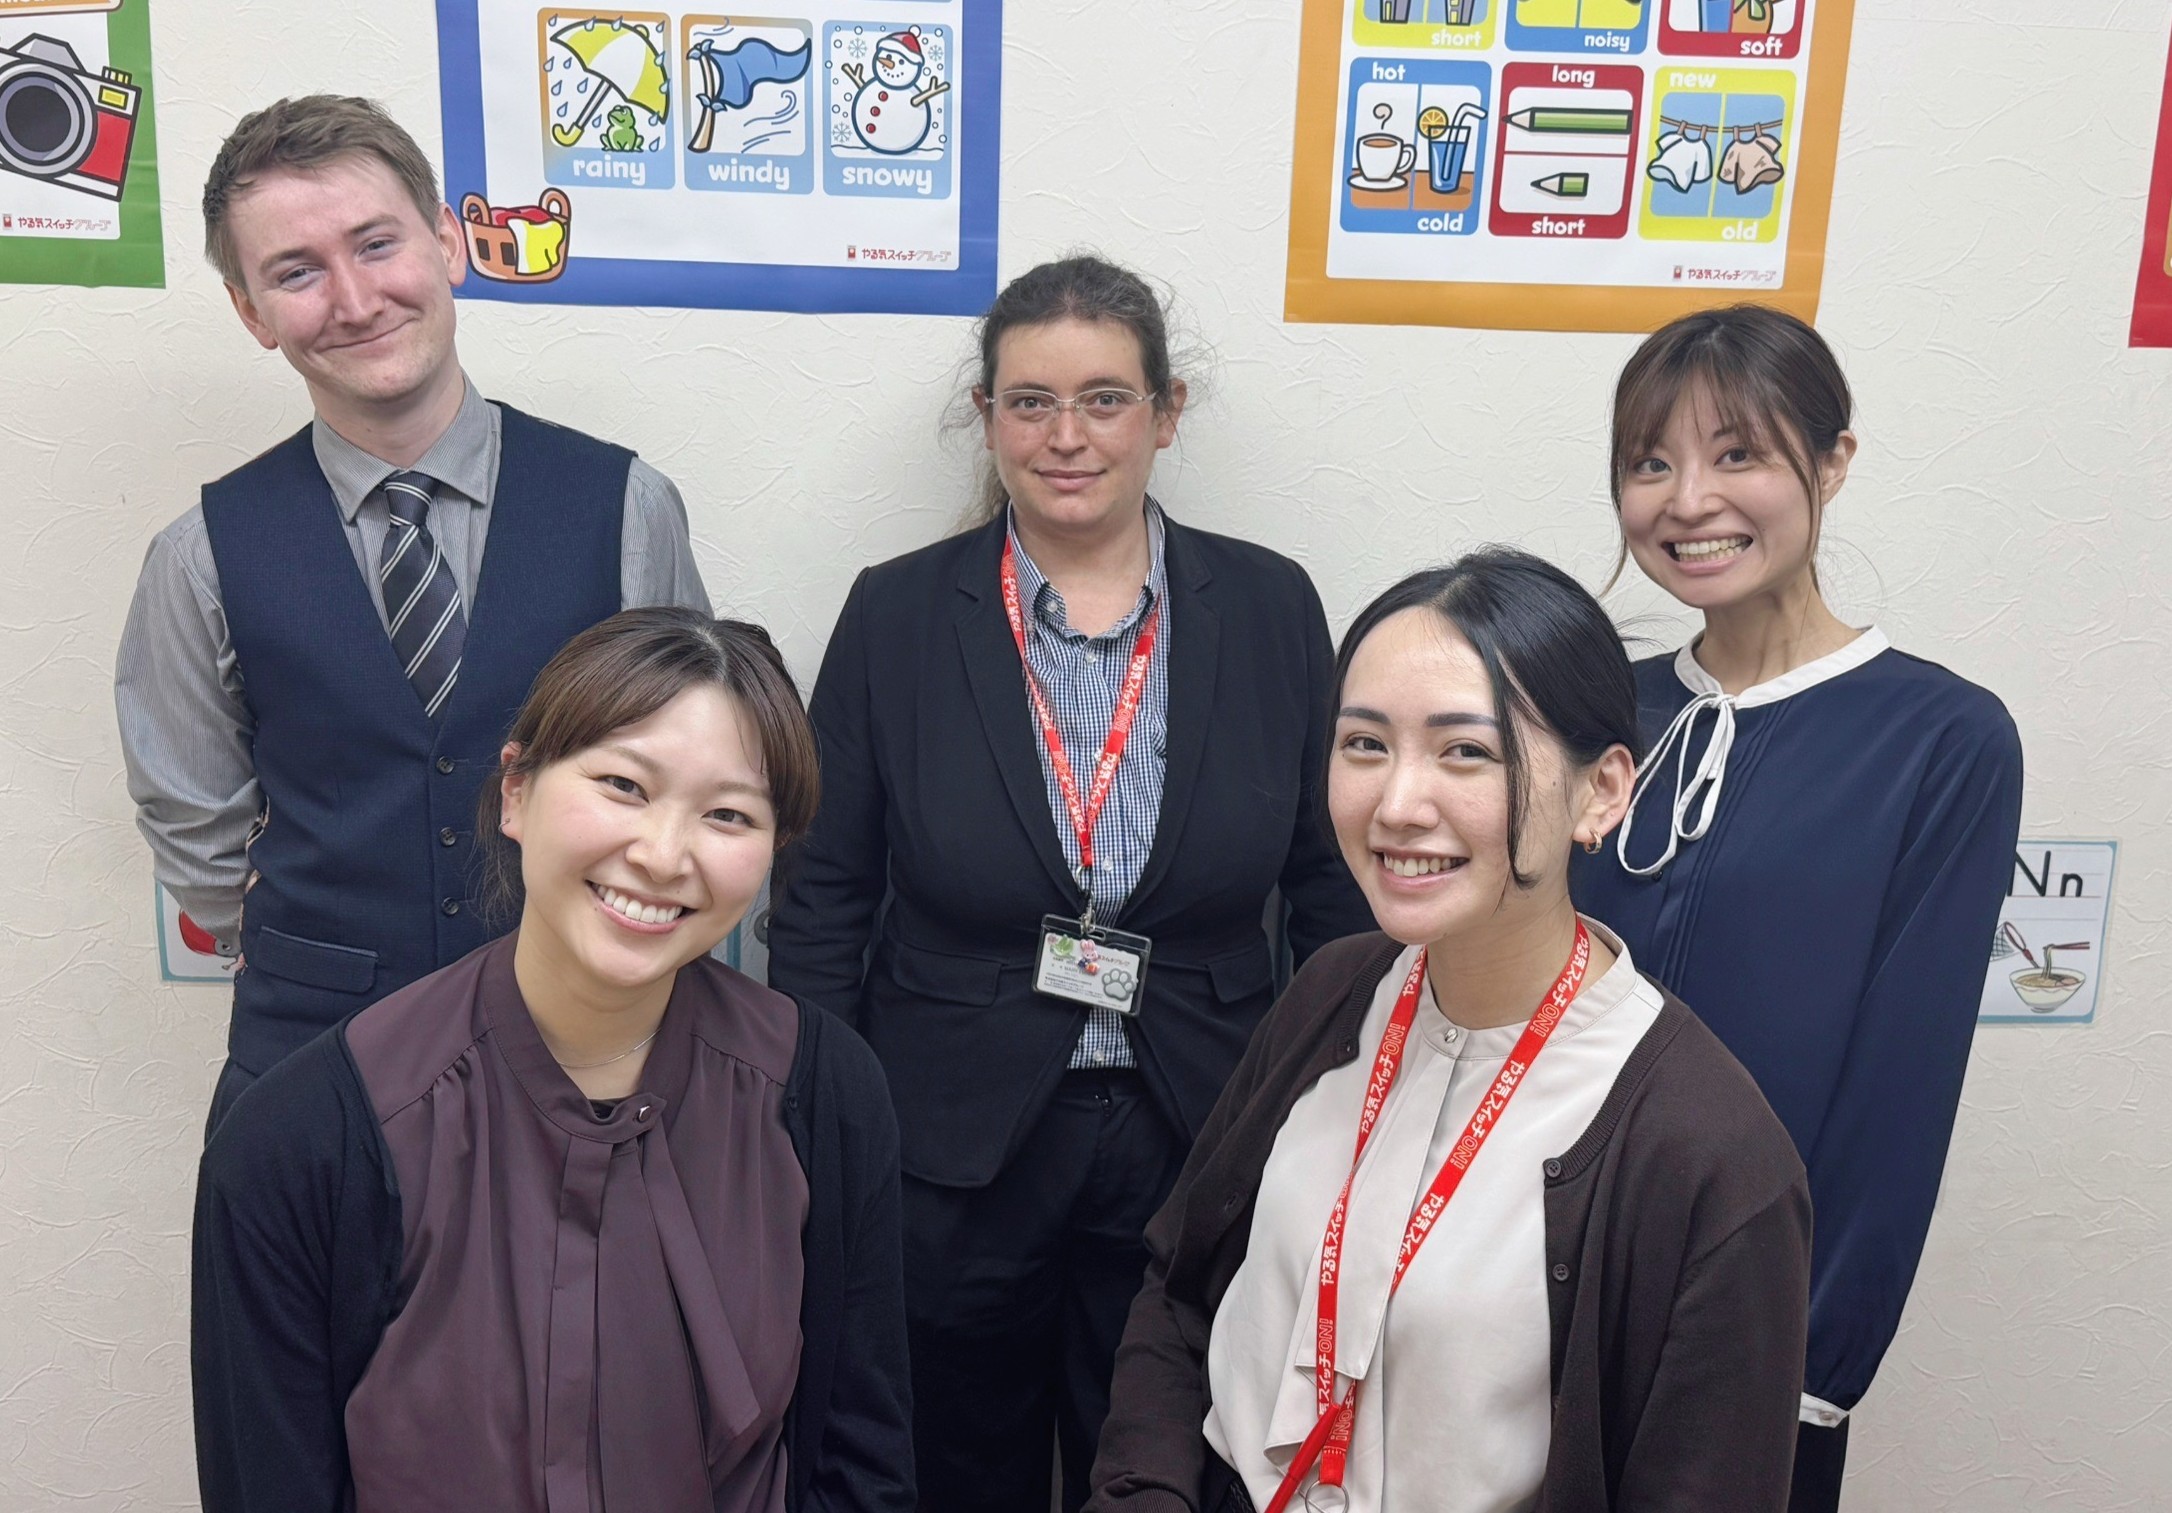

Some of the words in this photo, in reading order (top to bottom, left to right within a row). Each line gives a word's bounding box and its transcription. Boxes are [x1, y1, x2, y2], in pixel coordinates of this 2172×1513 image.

[1431, 29, 1481, 47] short
[1584, 31, 1631, 52] noisy
[1740, 36, 1783, 56] soft
[1372, 61, 1406, 81] hot
[1552, 65, 1596, 88] long
[1669, 72, 1717, 88] new
[572, 156, 646, 185] rainy
[708, 158, 790, 190] windy
[842, 165, 933, 195] snowy
[1417, 213, 1464, 232] cold
[1531, 216, 1586, 235] short
[1722, 221, 1758, 241] old
[1530, 933, 1589, 1037] やる気スイッチON!
[1361, 1022, 1407, 1134] やる気スイッチON!
[1450, 1060, 1526, 1170] やる気スイッチON!
